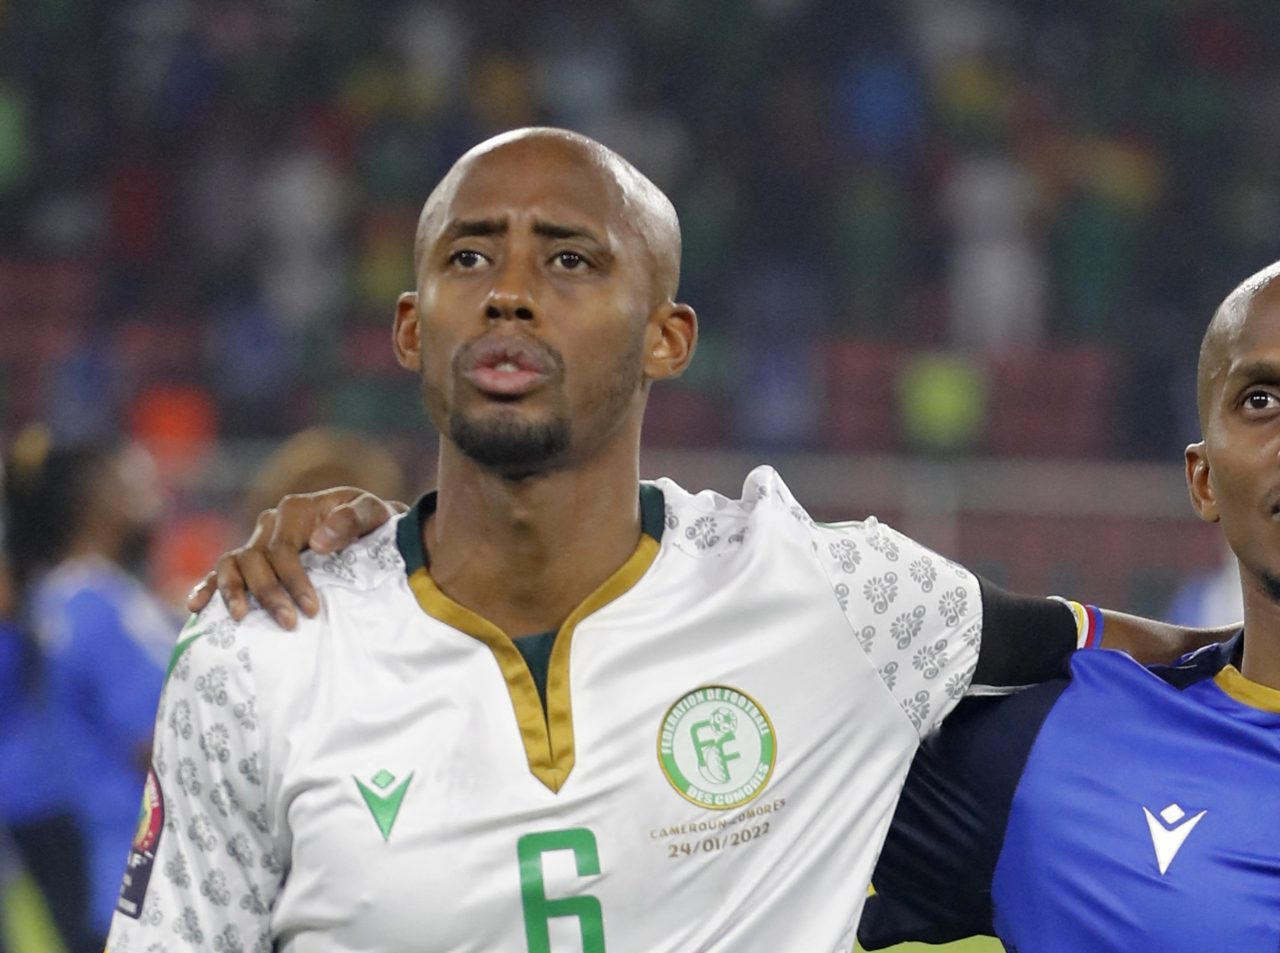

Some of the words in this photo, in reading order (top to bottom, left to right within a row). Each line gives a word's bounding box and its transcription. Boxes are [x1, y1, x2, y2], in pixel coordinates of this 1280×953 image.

[686, 784, 713, 804] DES
[714, 763, 770, 805] COMORES
[668, 822, 771, 858] 24/01/2022
